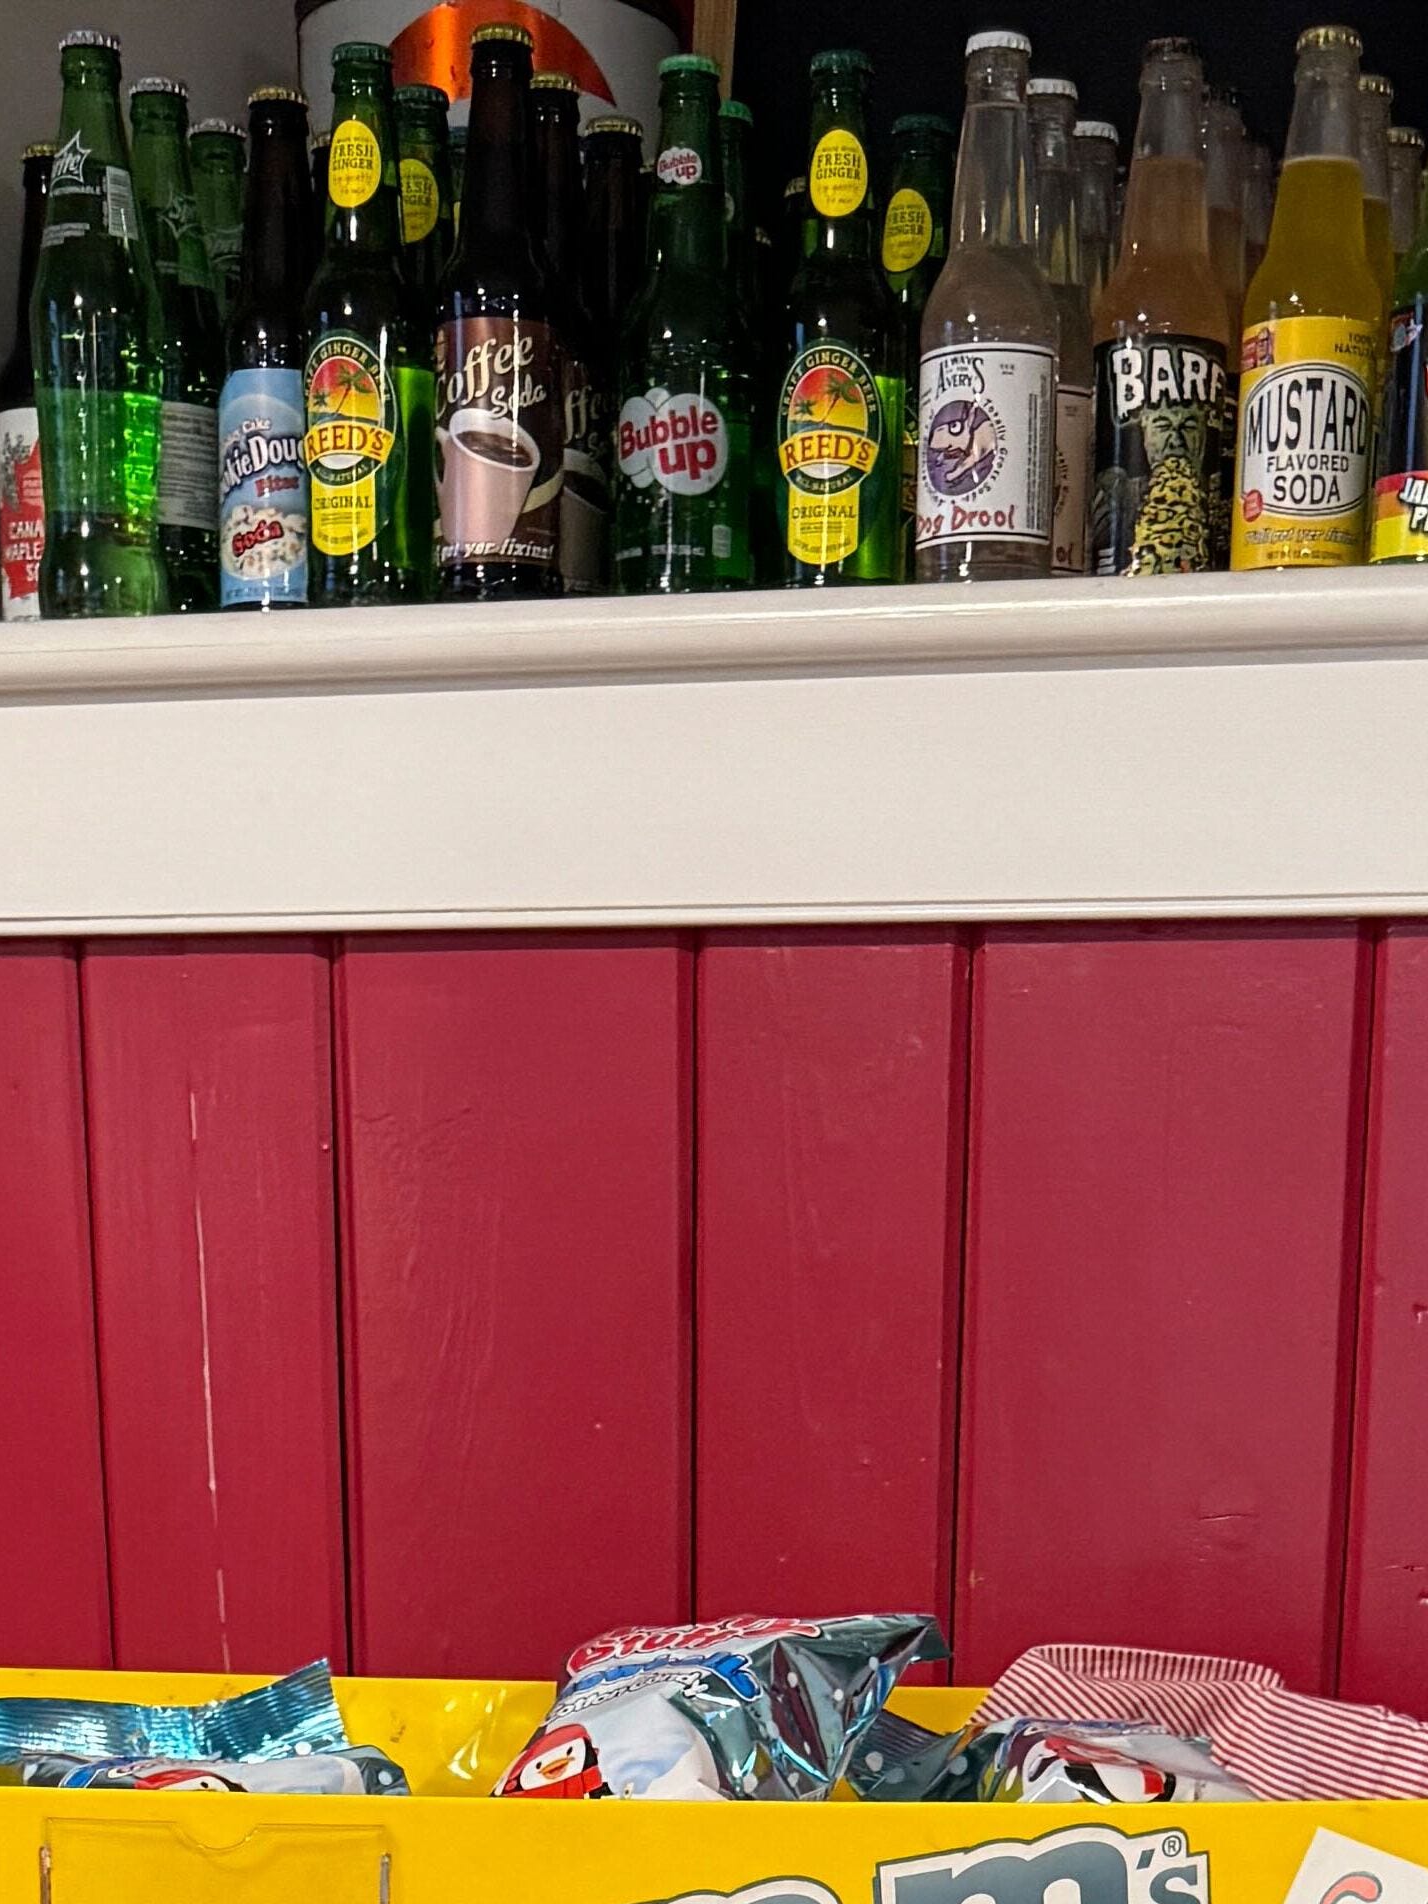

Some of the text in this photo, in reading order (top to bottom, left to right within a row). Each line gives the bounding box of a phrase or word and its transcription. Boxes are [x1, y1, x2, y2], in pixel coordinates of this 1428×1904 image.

[332, 143, 374, 159] FRESH
[658, 150, 698, 172] Bubble
[817, 153, 862, 168] FRESH
[675, 164, 697, 180] up
[816, 167, 861, 181] GINGER
[320, 340, 369, 367] GINGER
[806, 351, 859, 374] GINGER
[435, 336, 534, 420] Coffee
[1112, 348, 1227, 417] BARF
[490, 374, 547, 420] Soda
[1247, 377, 1370, 456] MUSTARD
[307, 424, 387, 460] REED'S
[620, 404, 718, 460] Bubble
[658, 437, 717, 481] up
[784, 434, 871, 469] REED'S
[1266, 454, 1349, 473] FLAVORED
[1273, 474, 1341, 504] SODA
[792, 505, 857, 520] ORIGINAL
[951, 504, 1015, 531] Drool
[9, 519, 44, 541] CANA
